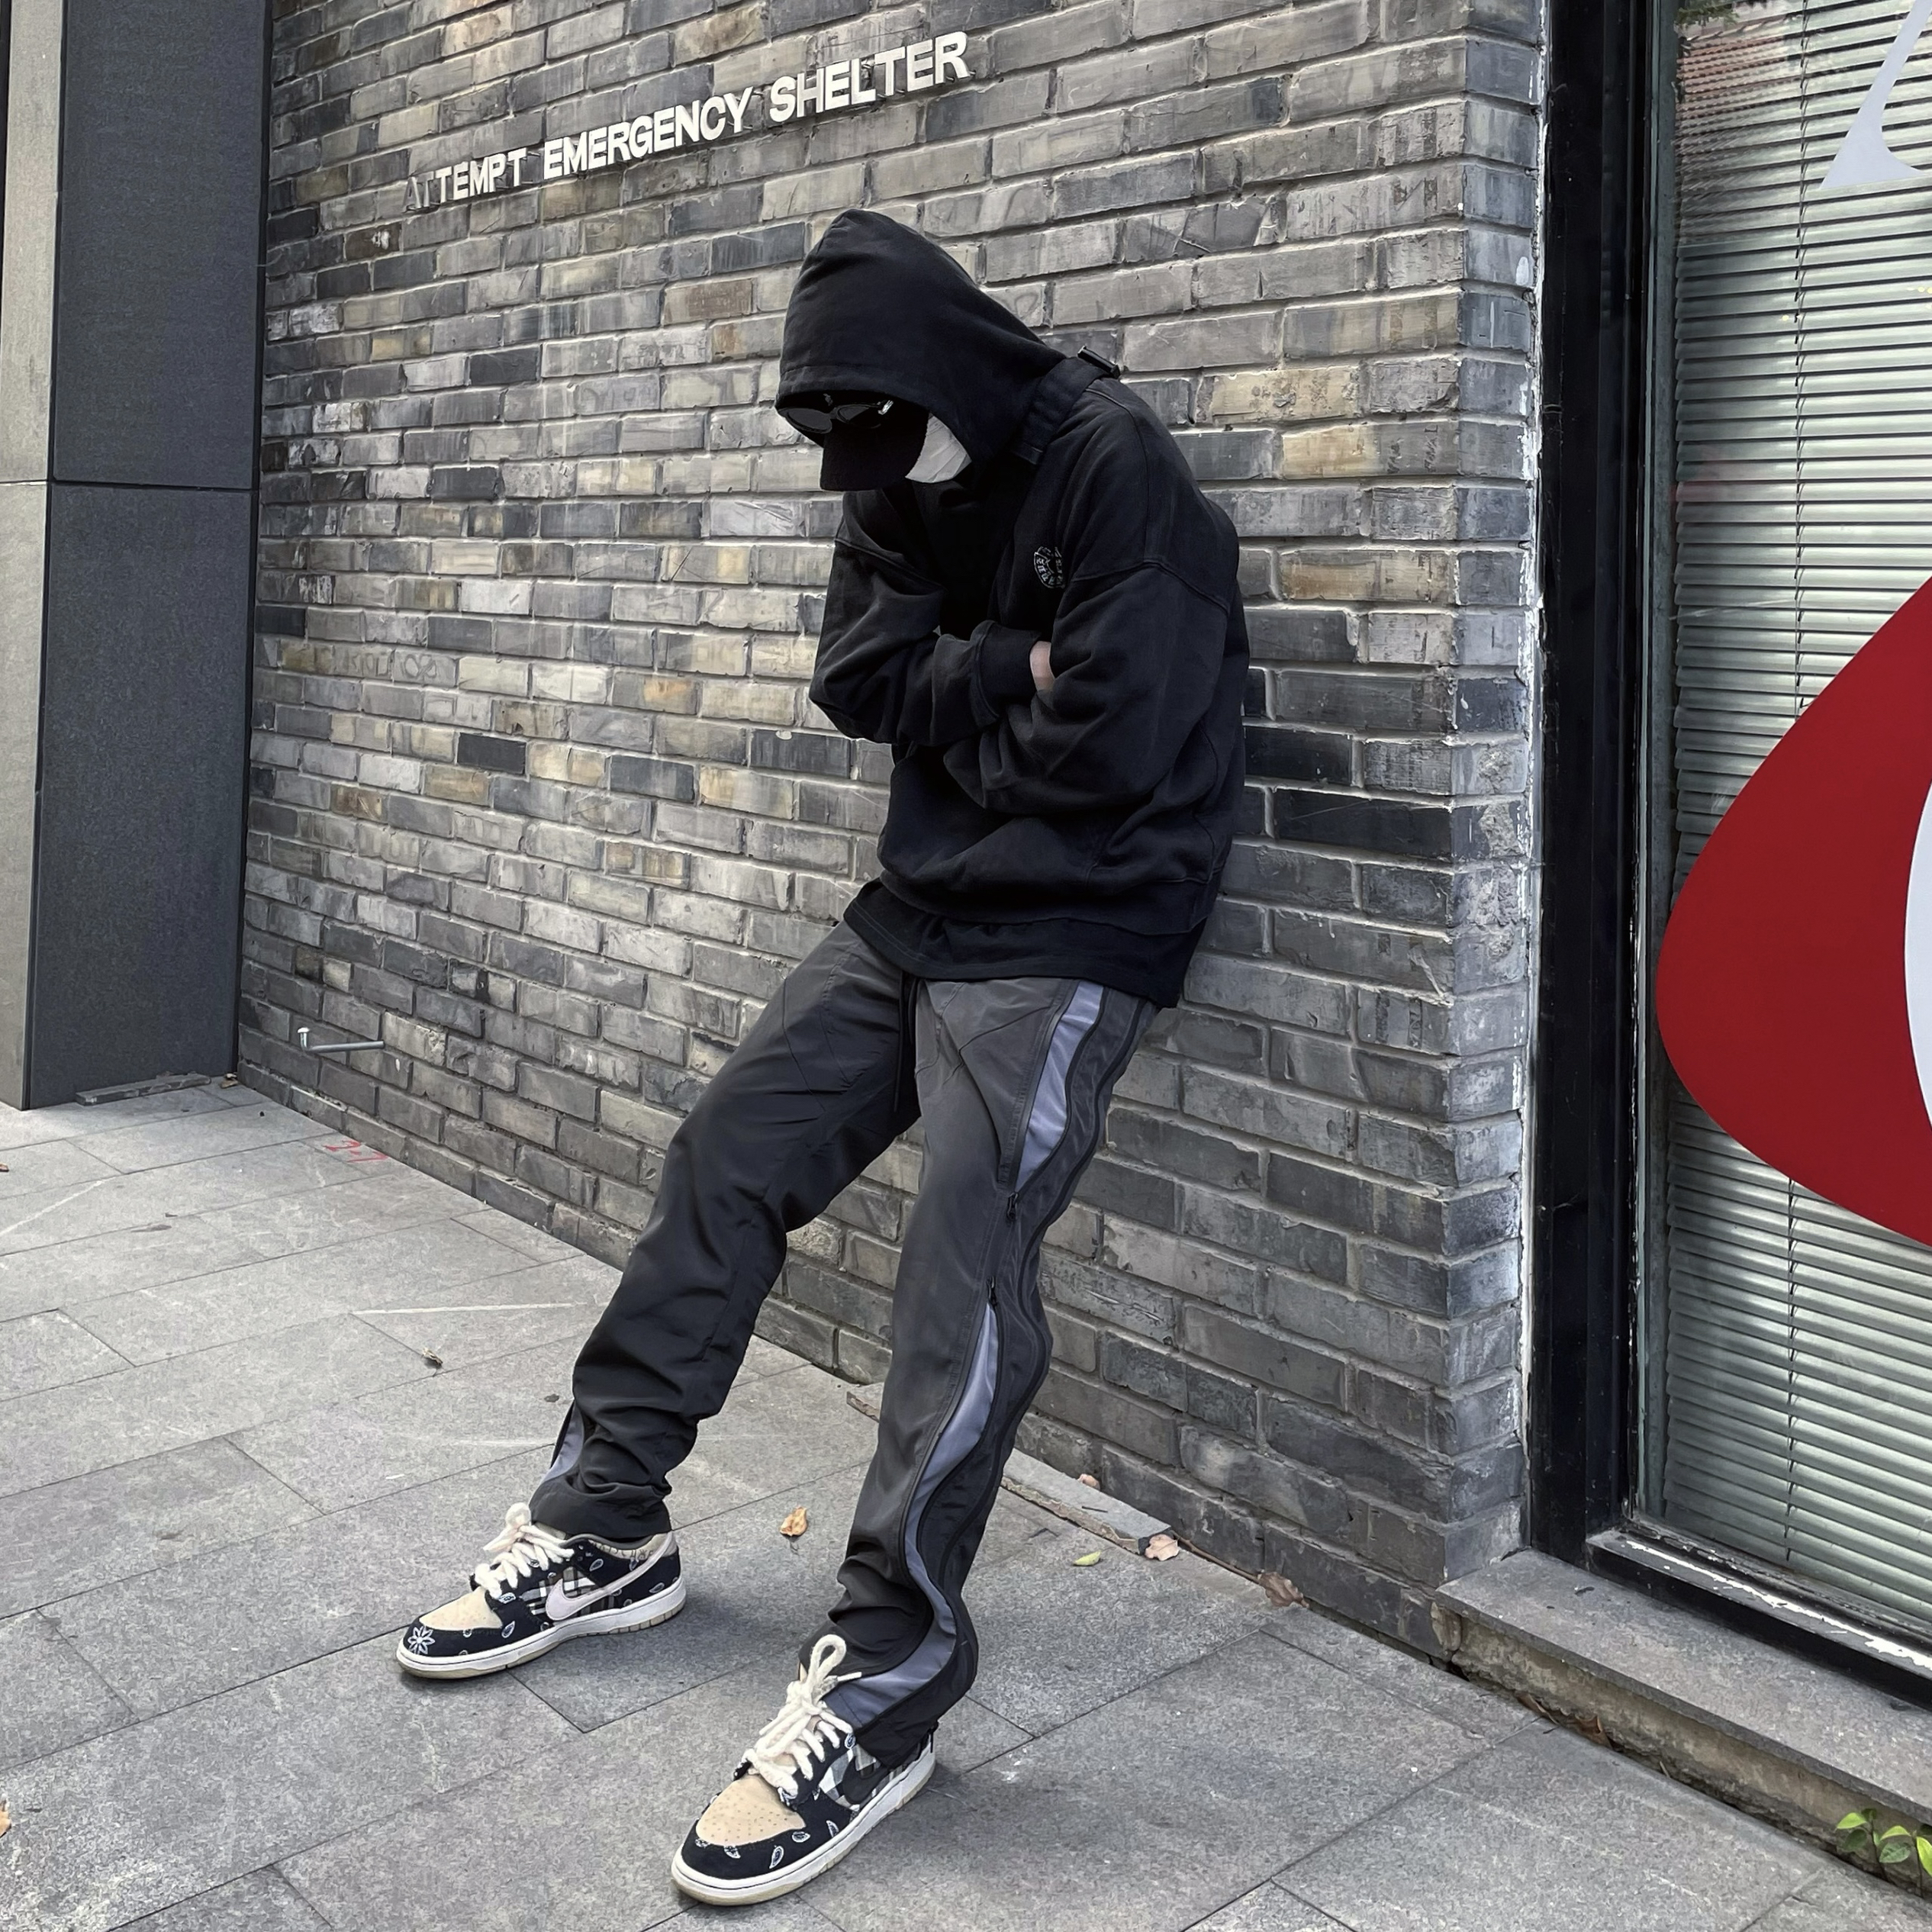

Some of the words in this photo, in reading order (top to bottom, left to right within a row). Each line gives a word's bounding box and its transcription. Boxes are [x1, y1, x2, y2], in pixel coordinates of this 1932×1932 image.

[402, 147, 526, 213] ATTEMPT
[543, 86, 753, 179] EMERGENCY
[769, 31, 968, 123] SHELTER
